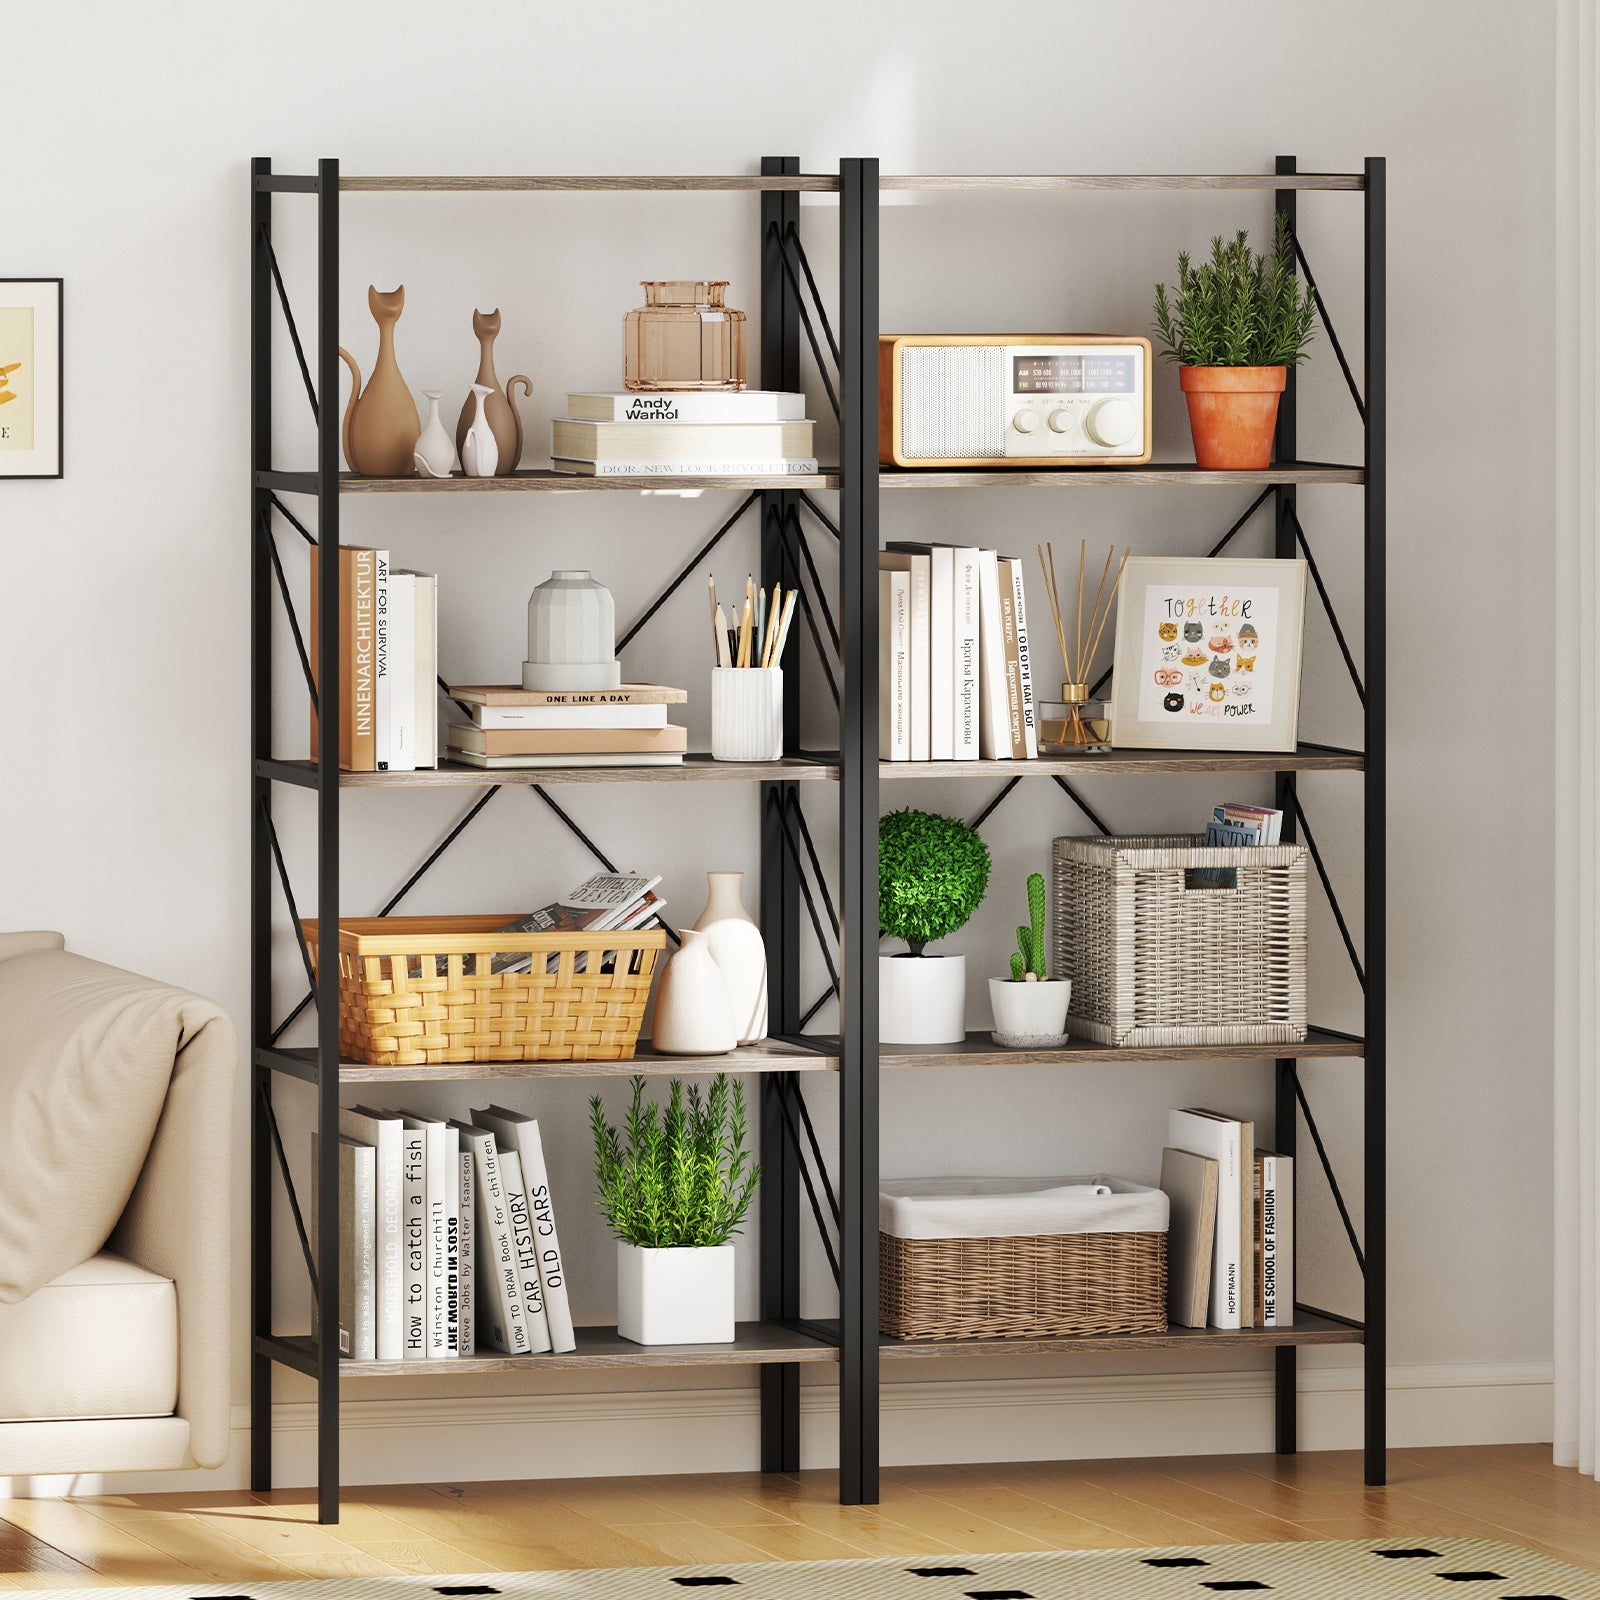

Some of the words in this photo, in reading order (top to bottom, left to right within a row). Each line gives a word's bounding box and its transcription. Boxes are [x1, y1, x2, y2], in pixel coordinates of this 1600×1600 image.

[625, 409, 679, 420] Warhol
[631, 398, 673, 411] Andy
[644, 463, 674, 474] NEW
[679, 463, 718, 474] LOOK
[378, 558, 387, 583] ART
[378, 588, 387, 615] FOR
[356, 550, 371, 737] INNENARCHITEKTUR
[378, 619, 387, 679] SURVIVAL
[960, 638, 974, 676] Братья
[1018, 628, 1030, 680] ГОВОРИ
[546, 695, 568, 703] ONE
[572, 695, 596, 703] LINE
[1022, 684, 1032, 705] КАК
[960, 678, 974, 745] Карамазовы
[1024, 709, 1034, 729] БОГ
[406, 1139, 422, 1182] fish
[484, 1140, 500, 1198] children
[462, 1154, 471, 1208] Isaacson
[410, 1195, 422, 1205] a
[494, 1205, 504, 1226] for
[531, 1185, 554, 1236] CARS
[1264, 1189, 1275, 1234] FASHION
[406, 1217, 422, 1271] catch
[432, 1202, 442, 1278] Churchill
[462, 1216, 471, 1256] Walter
[501, 1232, 511, 1262] Book
[508, 1192, 536, 1270] HISTORY
[1264, 1237, 1275, 1252] OF
[462, 1263, 472, 1277] by
[506, 1269, 517, 1298] DRAW
[543, 1250, 562, 1288] OLD
[1264, 1253, 1275, 1297] SCHOOL
[410, 1283, 422, 1304] to
[462, 1283, 471, 1309] Jobs
[525, 1279, 542, 1314] CAR
[1228, 1262, 1236, 1314] HOFFMANN
[432, 1286, 442, 1347] Winston
[511, 1304, 521, 1320] TO
[1264, 1299, 1275, 1321] THE
[407, 1316, 422, 1349] How
[462, 1317, 471, 1351] Steve
[515, 1325, 525, 1348] HOW
